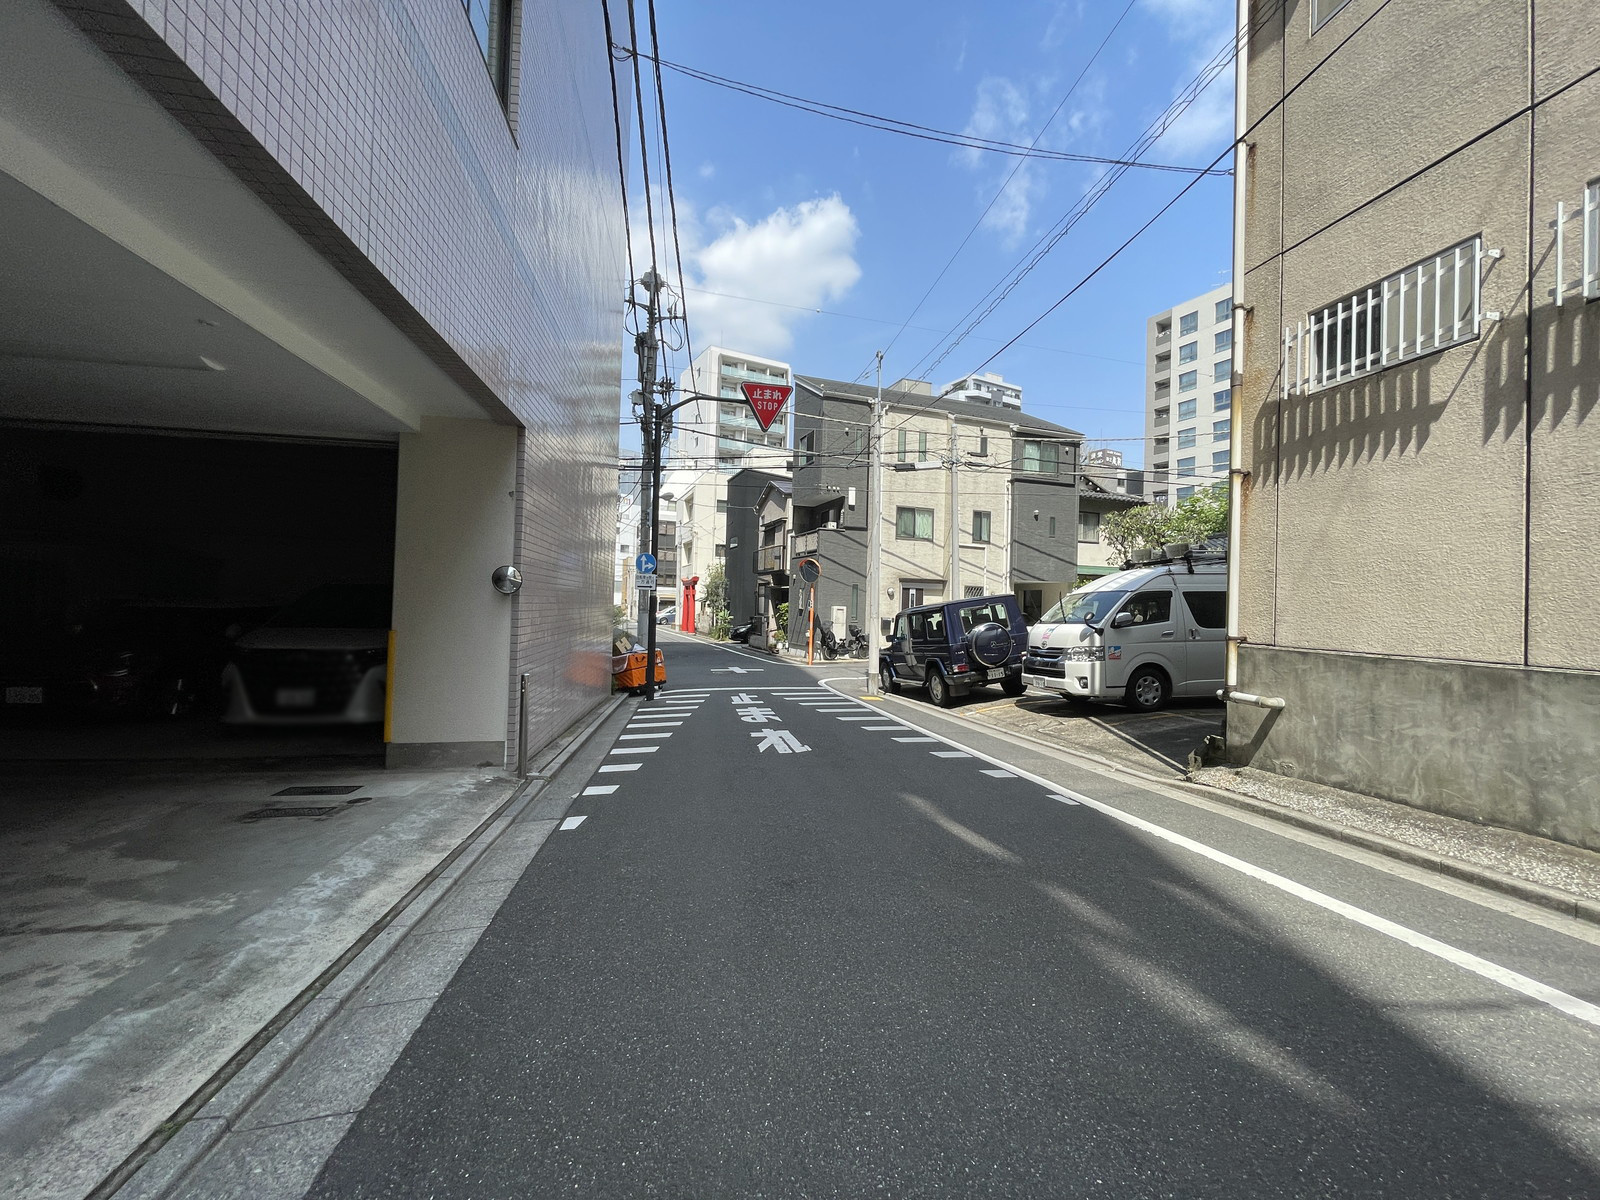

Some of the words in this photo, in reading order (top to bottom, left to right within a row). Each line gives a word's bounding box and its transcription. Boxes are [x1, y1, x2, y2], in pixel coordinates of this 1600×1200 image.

[752, 388, 782, 400] 止まれ
[757, 401, 778, 410] STOP
[730, 693, 812, 754] 止まれ
